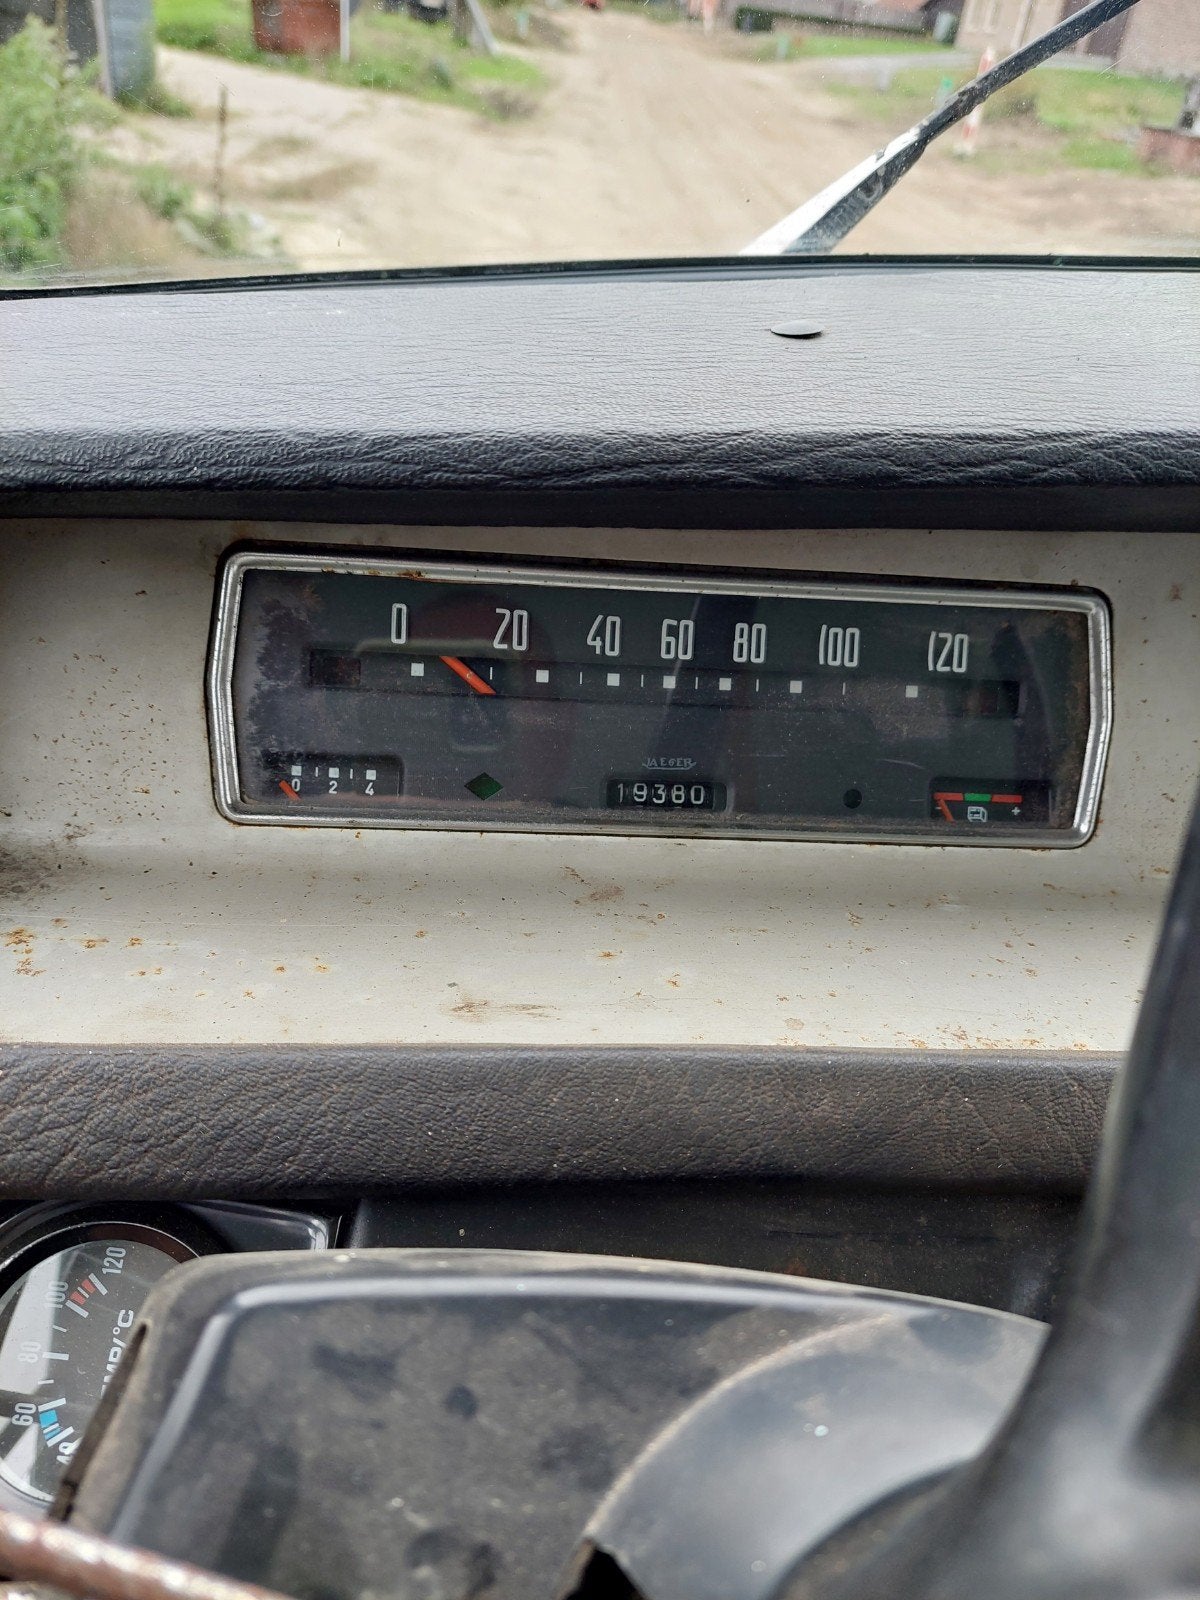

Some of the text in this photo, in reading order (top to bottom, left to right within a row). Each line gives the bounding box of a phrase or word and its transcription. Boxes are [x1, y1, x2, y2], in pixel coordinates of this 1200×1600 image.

[391, 603, 969, 673] 0 20 40 60 80 100 120
[643, 757, 696, 769] JAEGER
[291, 778, 375, 796] 0 2 4
[617, 783, 705, 805] 19380
[102, 1246, 126, 1275] 120
[45, 1281, 69, 1309] 100
[17, 1341, 41, 1363] 80
[11, 1402, 37, 1426] 60
